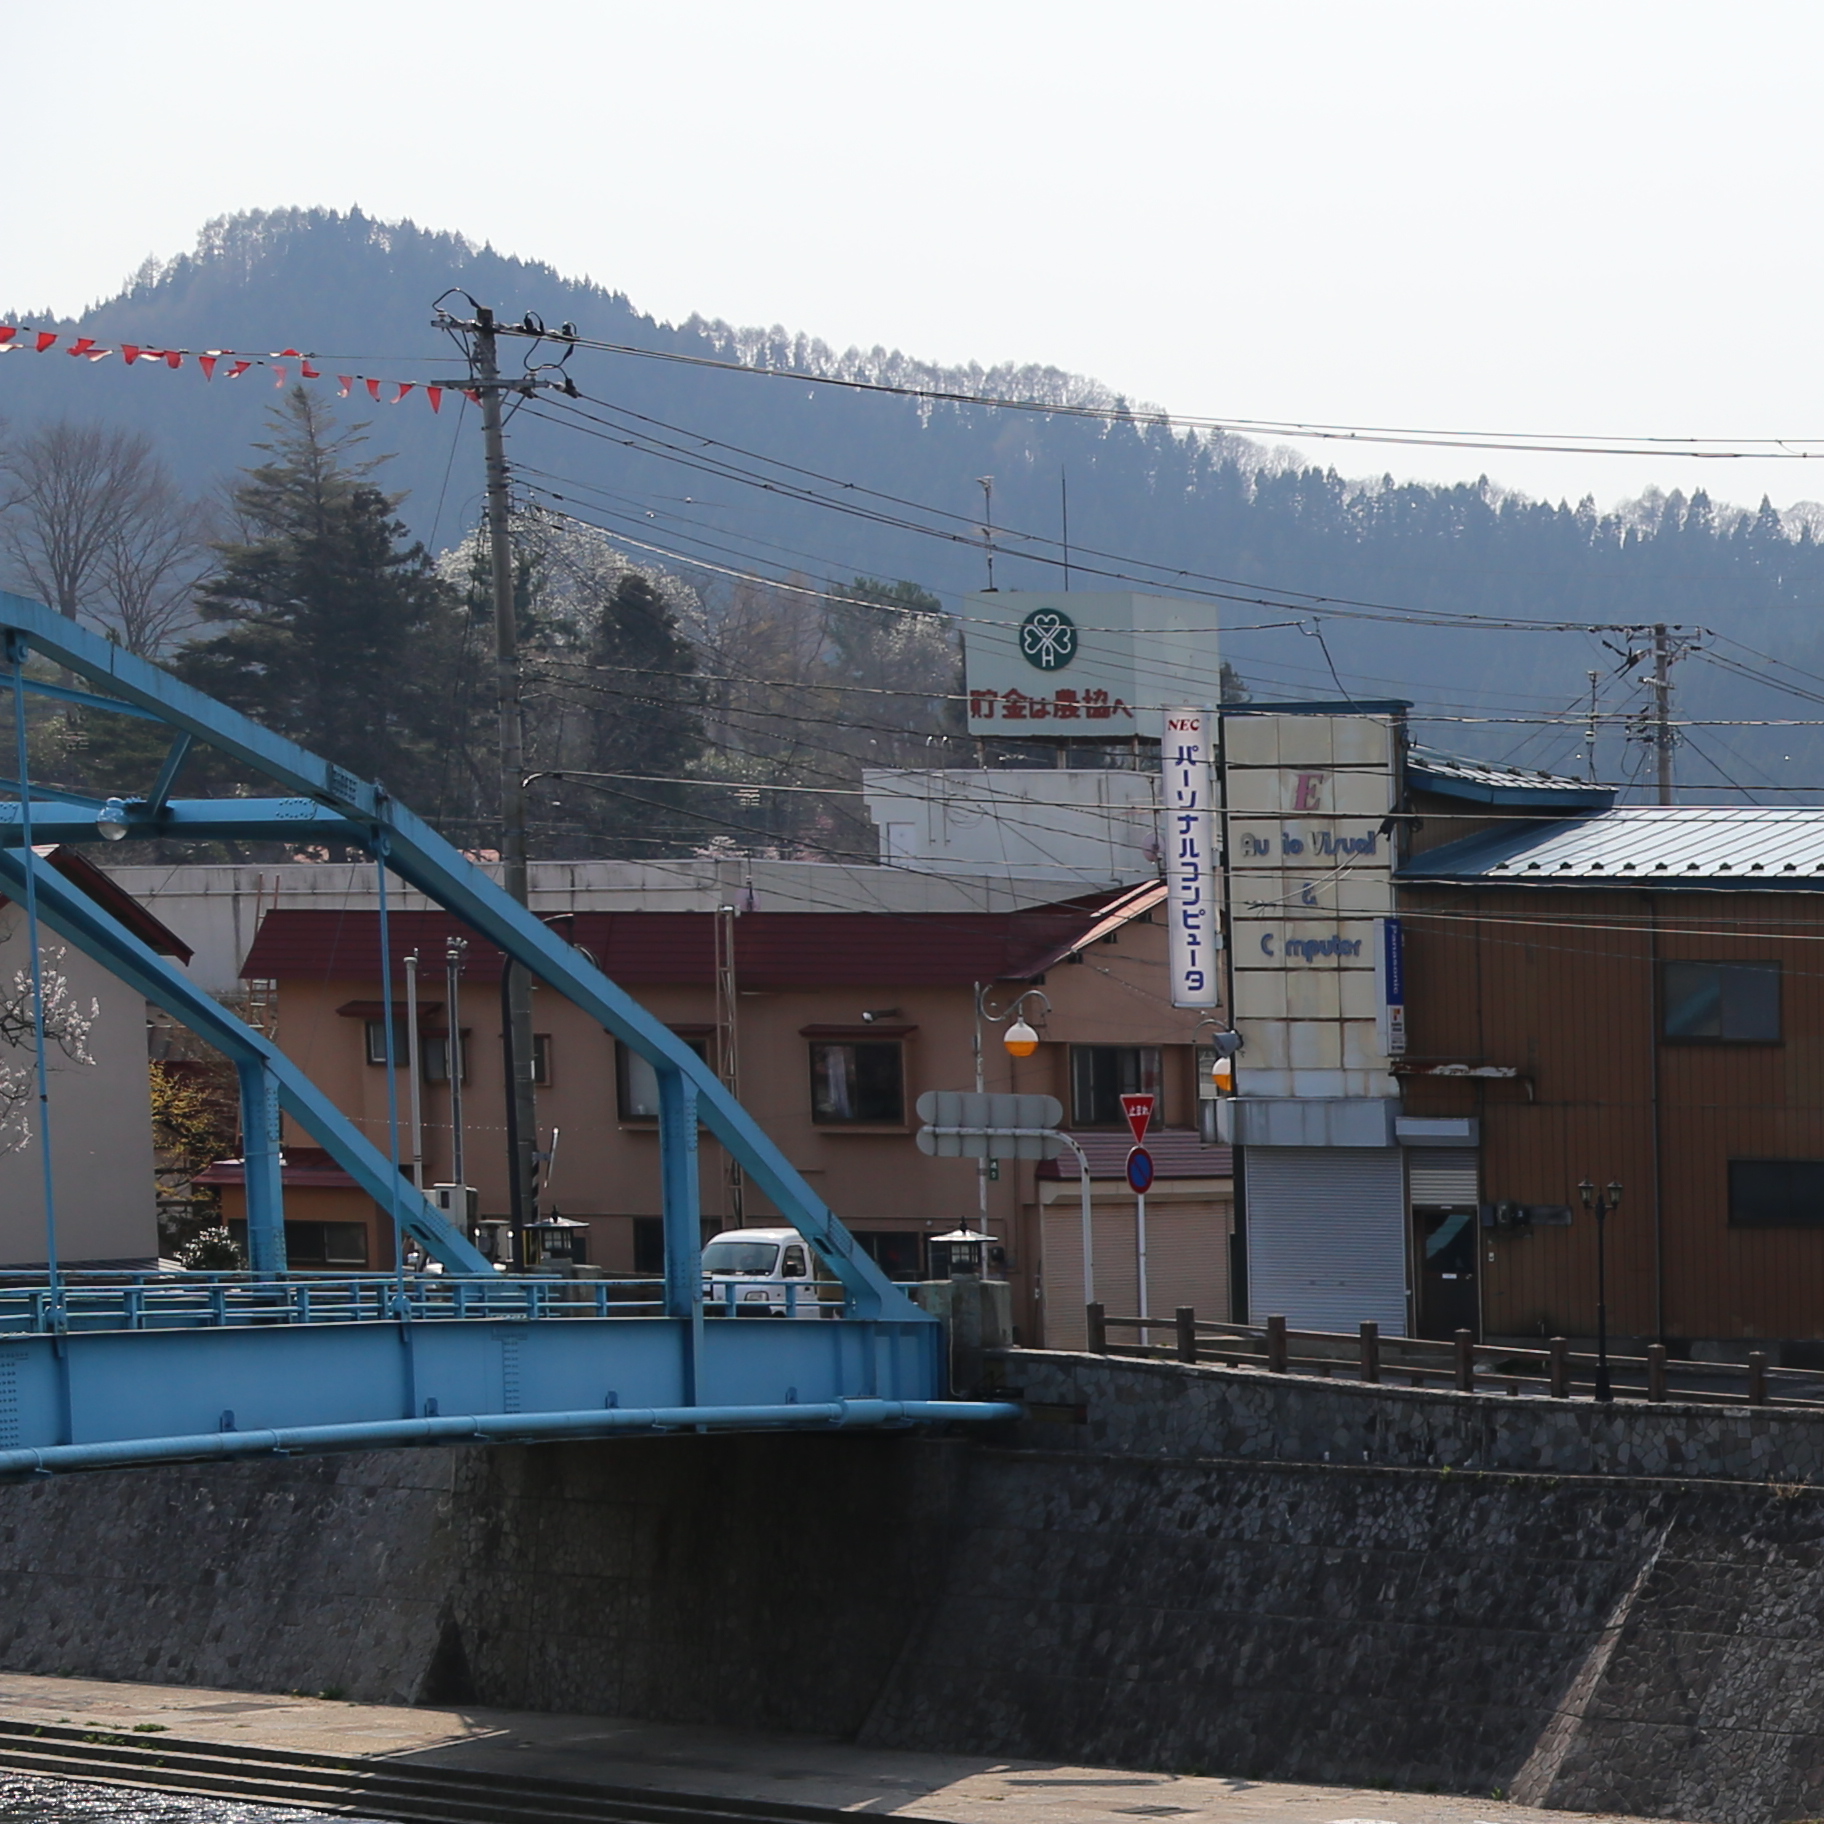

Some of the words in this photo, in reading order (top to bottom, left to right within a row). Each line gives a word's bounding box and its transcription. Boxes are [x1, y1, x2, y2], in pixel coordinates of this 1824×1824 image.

[970, 688, 1133, 719] 貯金は農協へ
[1168, 719, 1199, 731] NEC
[1174, 746, 1206, 991] パーソナルコンピュータ
[1261, 933, 1362, 963] Cmputer
[1391, 924, 1400, 994] Panasonic
[1128, 1104, 1150, 1117] 止まれ
